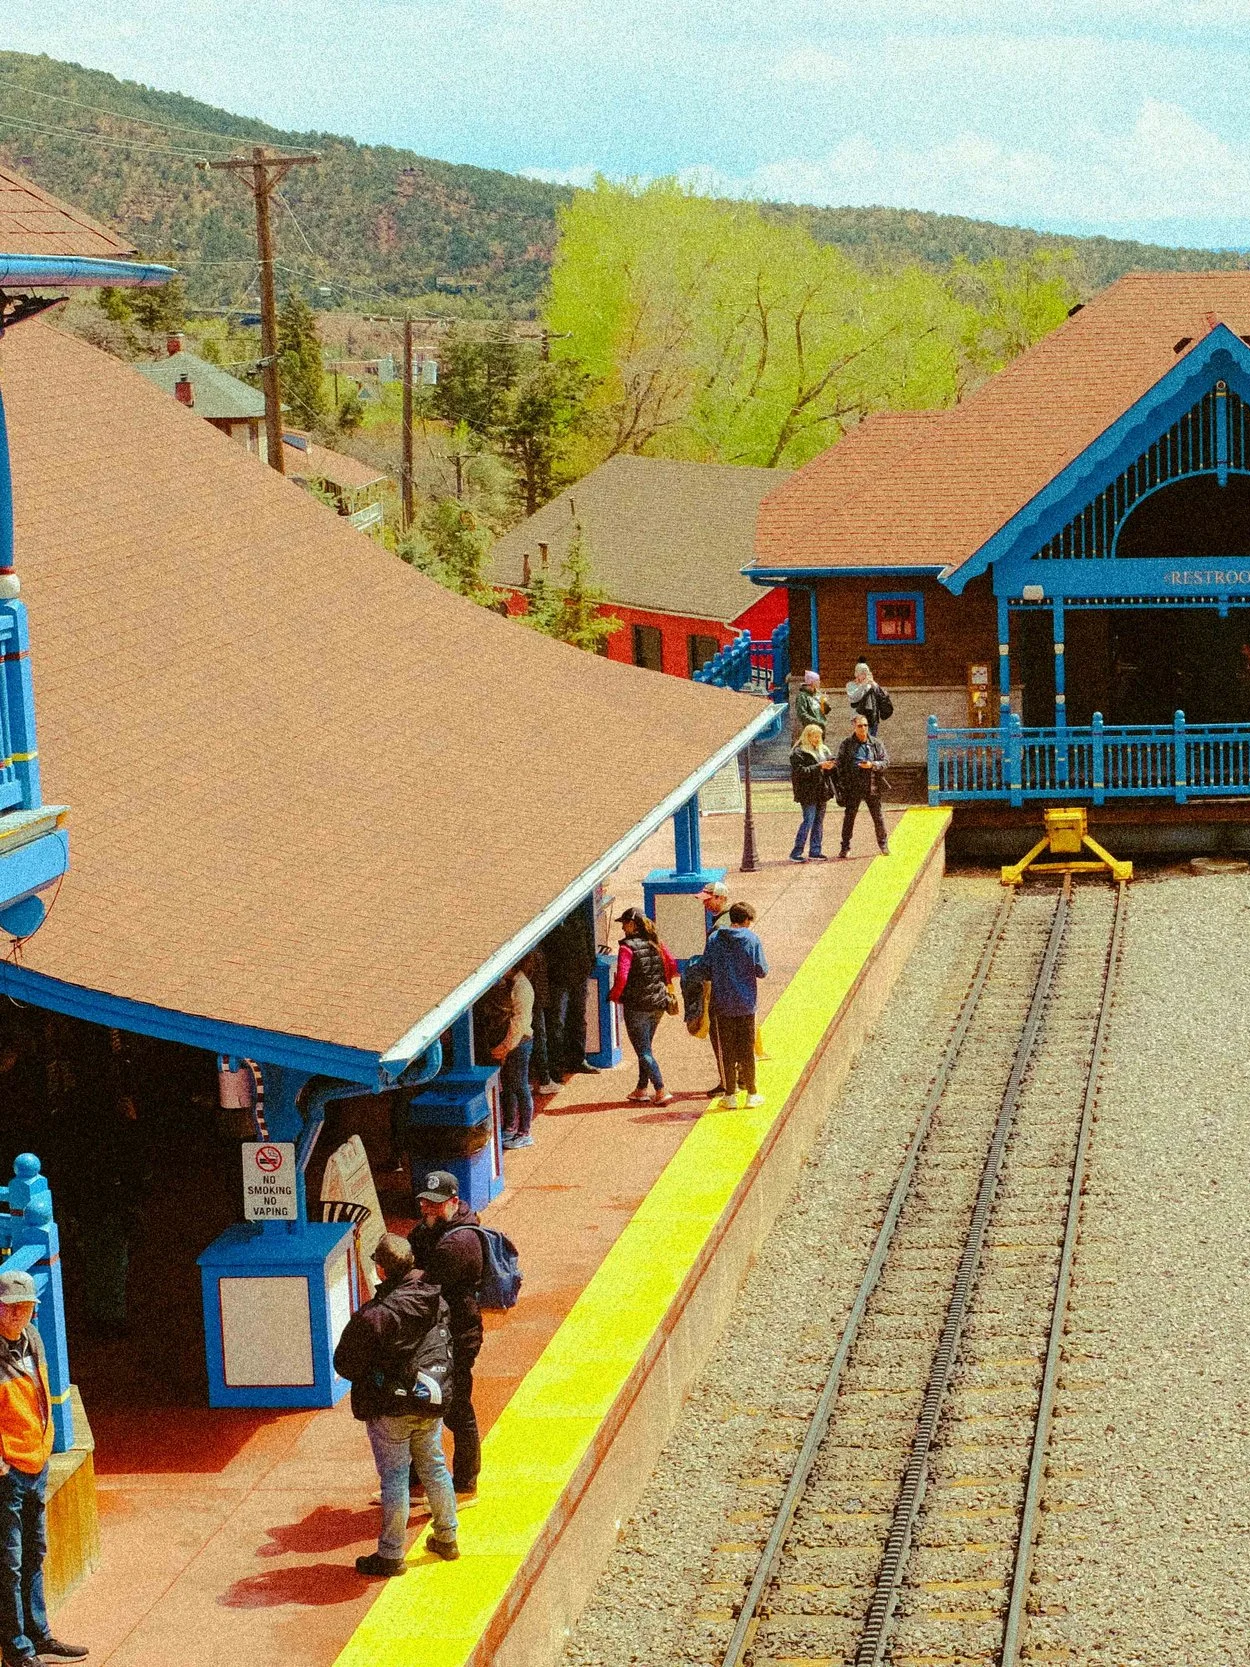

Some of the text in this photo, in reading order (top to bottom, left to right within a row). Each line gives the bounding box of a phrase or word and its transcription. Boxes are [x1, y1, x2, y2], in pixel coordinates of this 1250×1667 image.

[262, 1175, 276, 1184] NO
[247, 1186, 292, 1195] SMOKING
[263, 1196, 277, 1205] NO
[253, 1207, 288, 1216] VAPING
